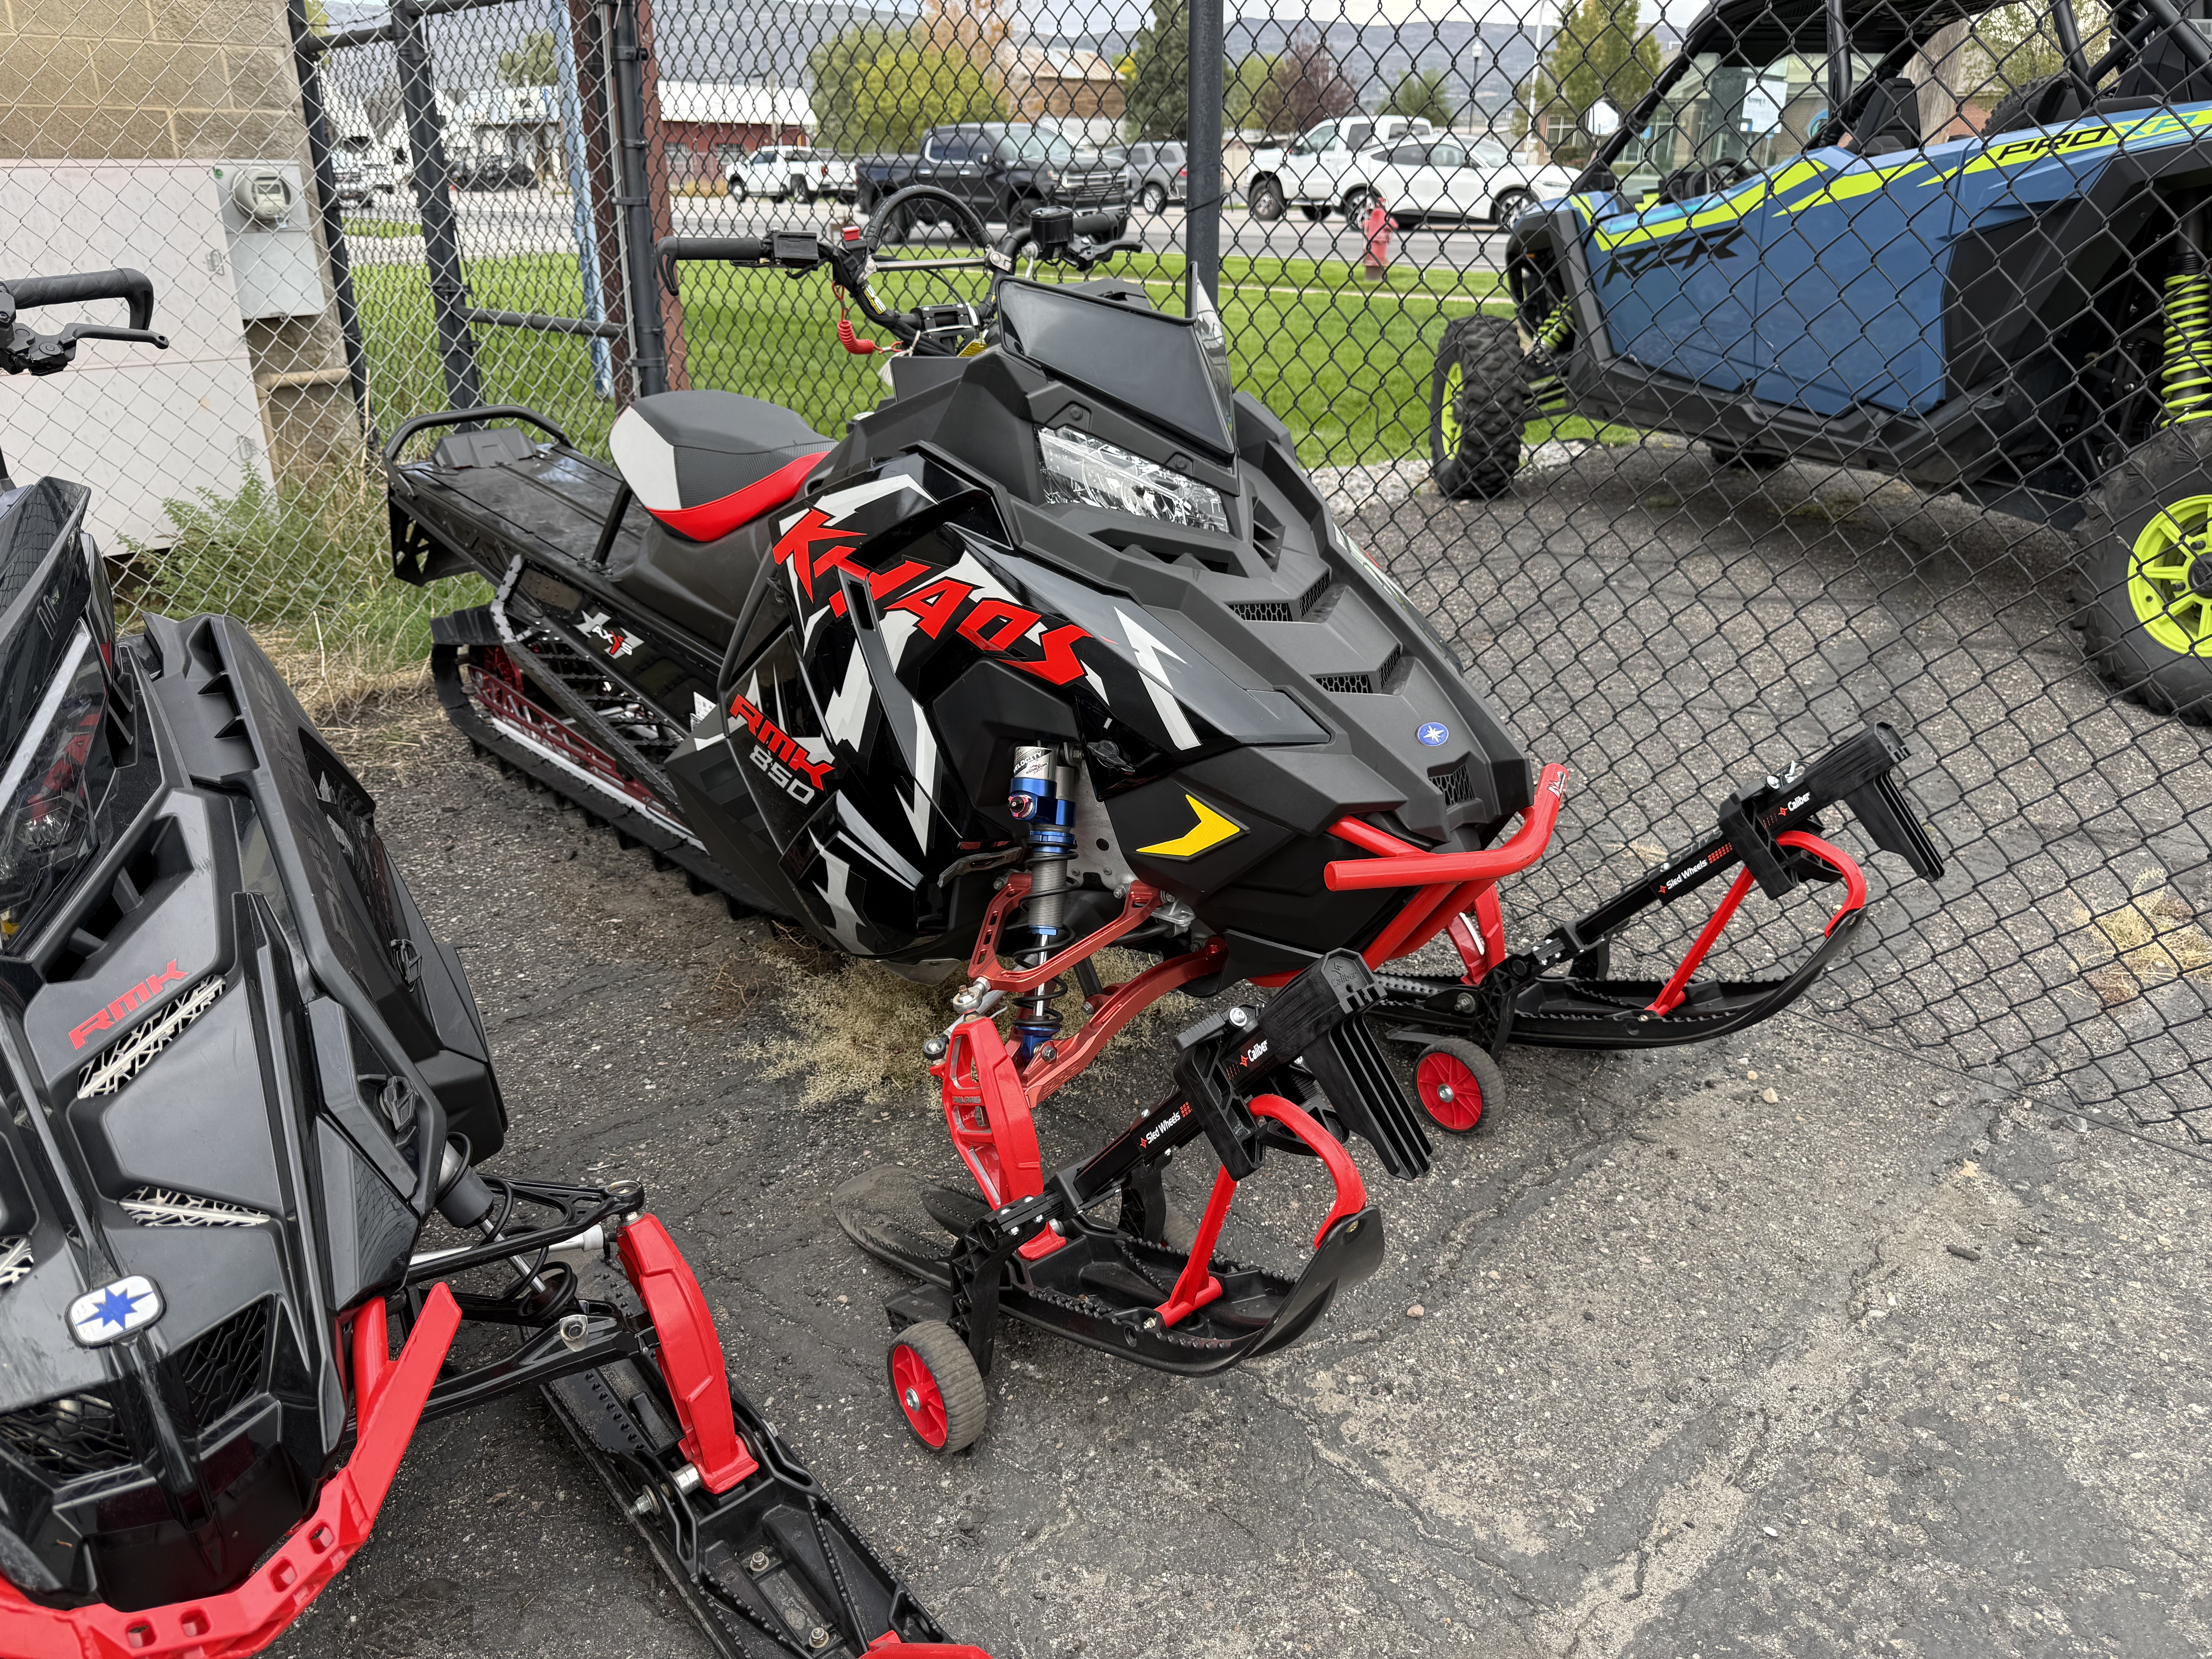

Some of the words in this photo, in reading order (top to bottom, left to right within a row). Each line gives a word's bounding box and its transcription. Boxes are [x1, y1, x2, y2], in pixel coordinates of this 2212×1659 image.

[773, 508, 1118, 685] KHAOS
[592, 625, 633, 656] AXYS
[730, 694, 836, 792] RMK
[749, 744, 815, 805] 850
[1788, 792, 1810, 811] Caliber
[1666, 874, 1683, 890] Sled
[1681, 859, 1708, 879] Wheels
[1331, 972, 1357, 987] Caliber
[68, 958, 189, 1050] RMK
[1247, 1039, 1268, 1062] Caliber
[1146, 1126, 1160, 1144] Sled
[1158, 1112, 1181, 1133] Wheels
